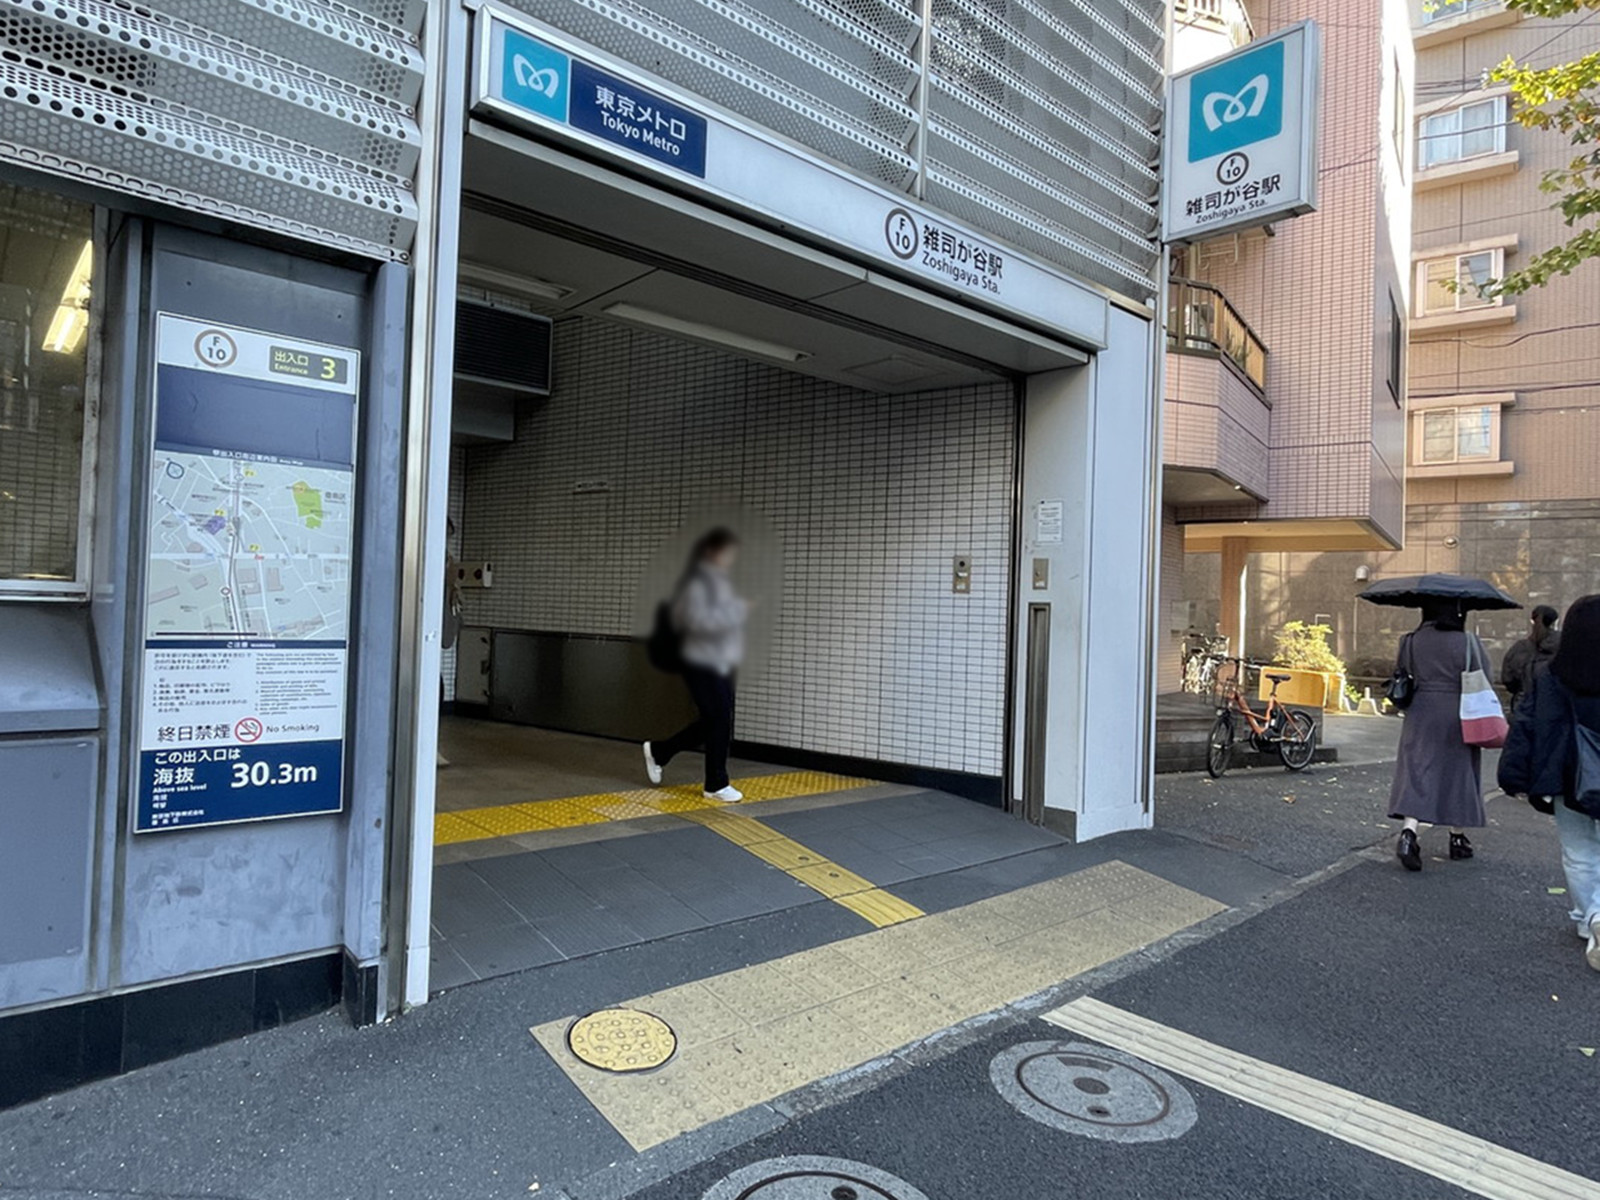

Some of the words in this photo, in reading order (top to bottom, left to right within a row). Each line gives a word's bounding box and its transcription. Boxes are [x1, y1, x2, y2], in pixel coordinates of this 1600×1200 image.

[595, 85, 686, 141] 東京メトロ
[600, 110, 640, 140] Tokyo
[642, 127, 680, 156] Metro
[1226, 166, 1241, 178] 10
[1186, 174, 1280, 217] 雑司が谷駅
[1195, 205, 1246, 224] Zoshigaya
[1248, 199, 1268, 211] Sta.
[900, 217, 906, 231] F
[895, 231, 910, 250] 10
[923, 224, 1003, 280] 雑司が谷駅
[922, 251, 978, 286] Zoshigaya
[981, 275, 1001, 294] Sta.
[213, 336, 220, 346] F
[207, 347, 226, 361] 10
[274, 351, 309, 366] 出入口
[320, 357, 336, 379] 3
[274, 364, 309, 375] Entrance
[157, 724, 231, 743] 終日禁煙
[266, 725, 280, 733] No
[282, 724, 320, 733] Smoking
[155, 748, 242, 765] この出入口は
[153, 766, 195, 786] 海抜
[230, 761, 318, 789] 30.3m
[153, 786, 175, 794] Above
[190, 783, 207, 791] level
